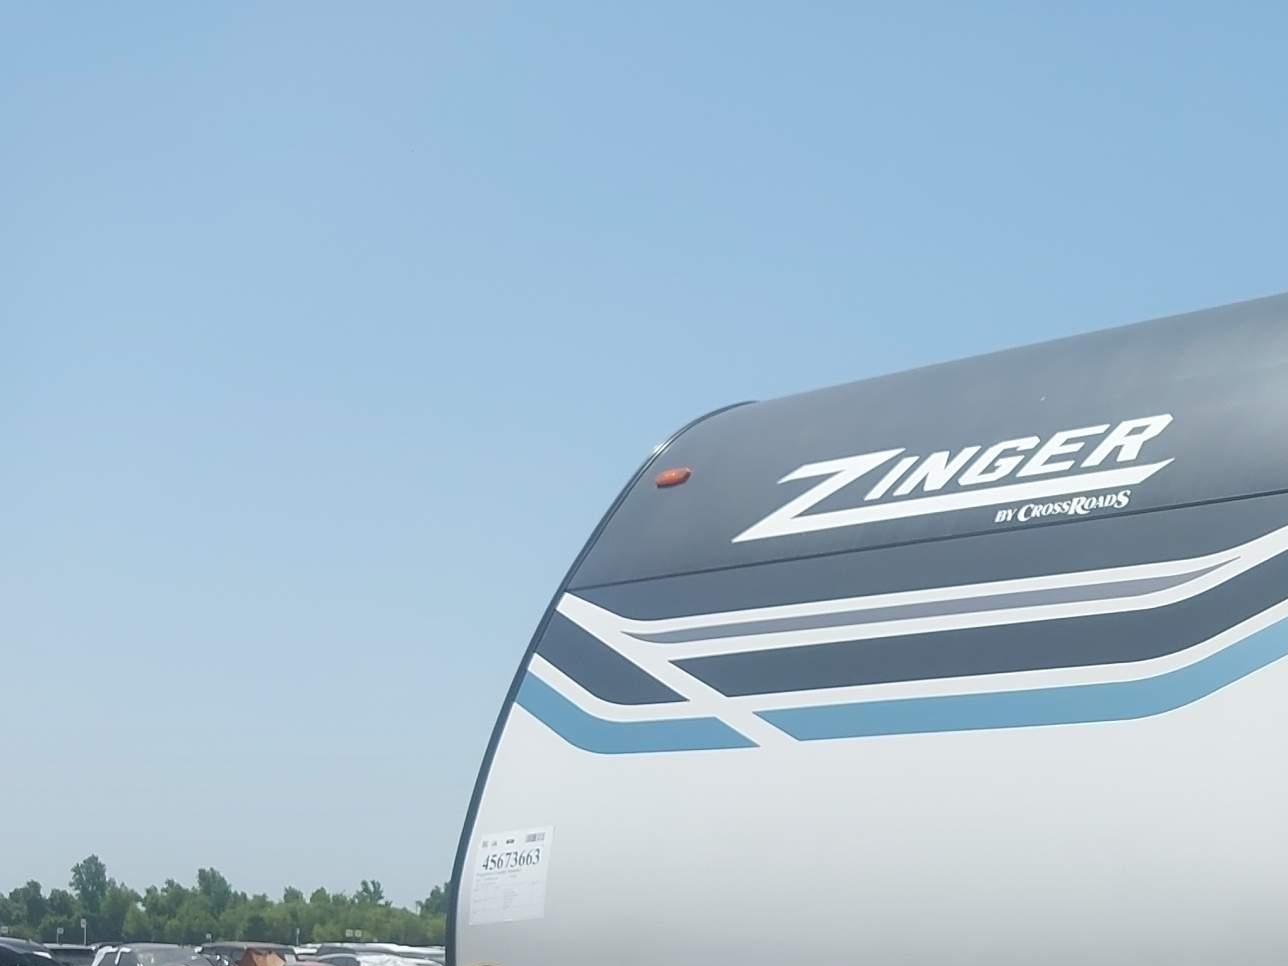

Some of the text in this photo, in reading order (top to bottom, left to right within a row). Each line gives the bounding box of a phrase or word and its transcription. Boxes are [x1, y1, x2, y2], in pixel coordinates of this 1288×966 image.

[731, 413, 1175, 543] ZINGER
[994, 508, 1017, 523] BY
[482, 848, 541, 871] 45673663
